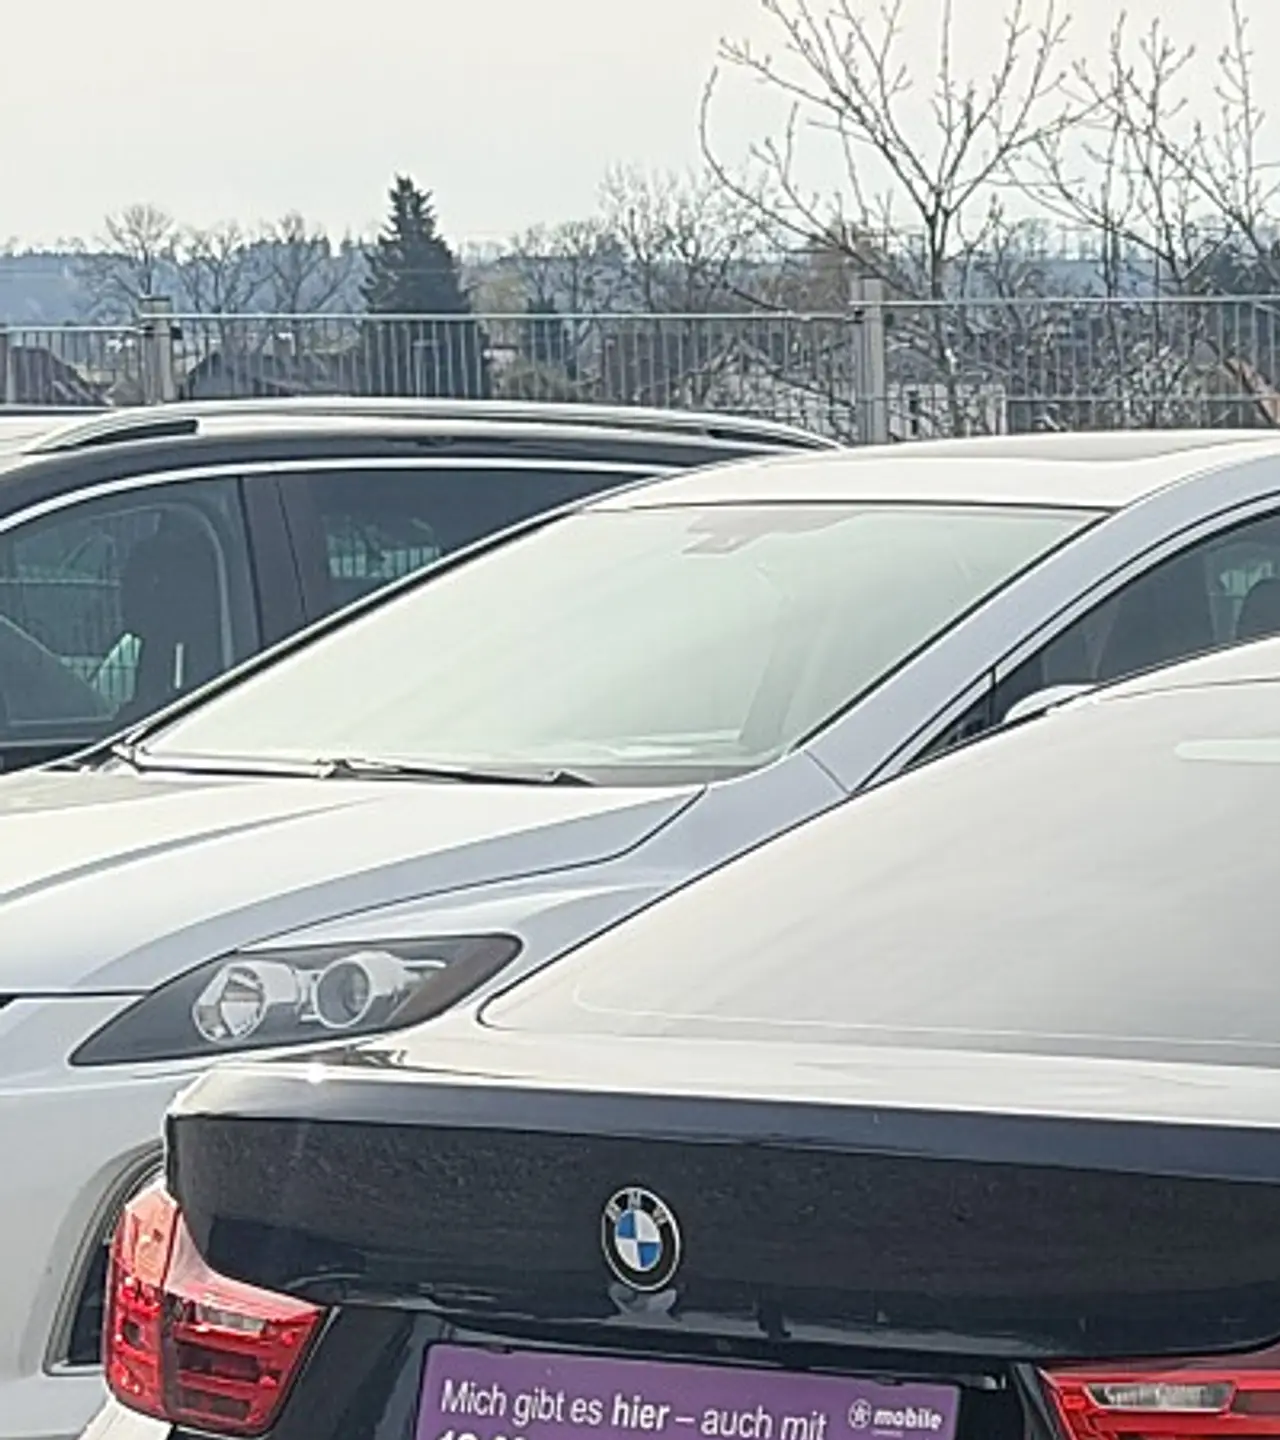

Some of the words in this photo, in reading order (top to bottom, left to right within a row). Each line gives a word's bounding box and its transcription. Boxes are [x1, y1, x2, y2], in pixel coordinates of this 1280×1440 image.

[604, 1190, 668, 1224] BMW
[440, 1379, 506, 1417] Mich
[512, 1387, 565, 1427] gibt
[570, 1399, 603, 1426] es
[611, 1392, 670, 1432] hier
[700, 1405, 772, 1440] auch
[873, 1408, 943, 1431] mobile
